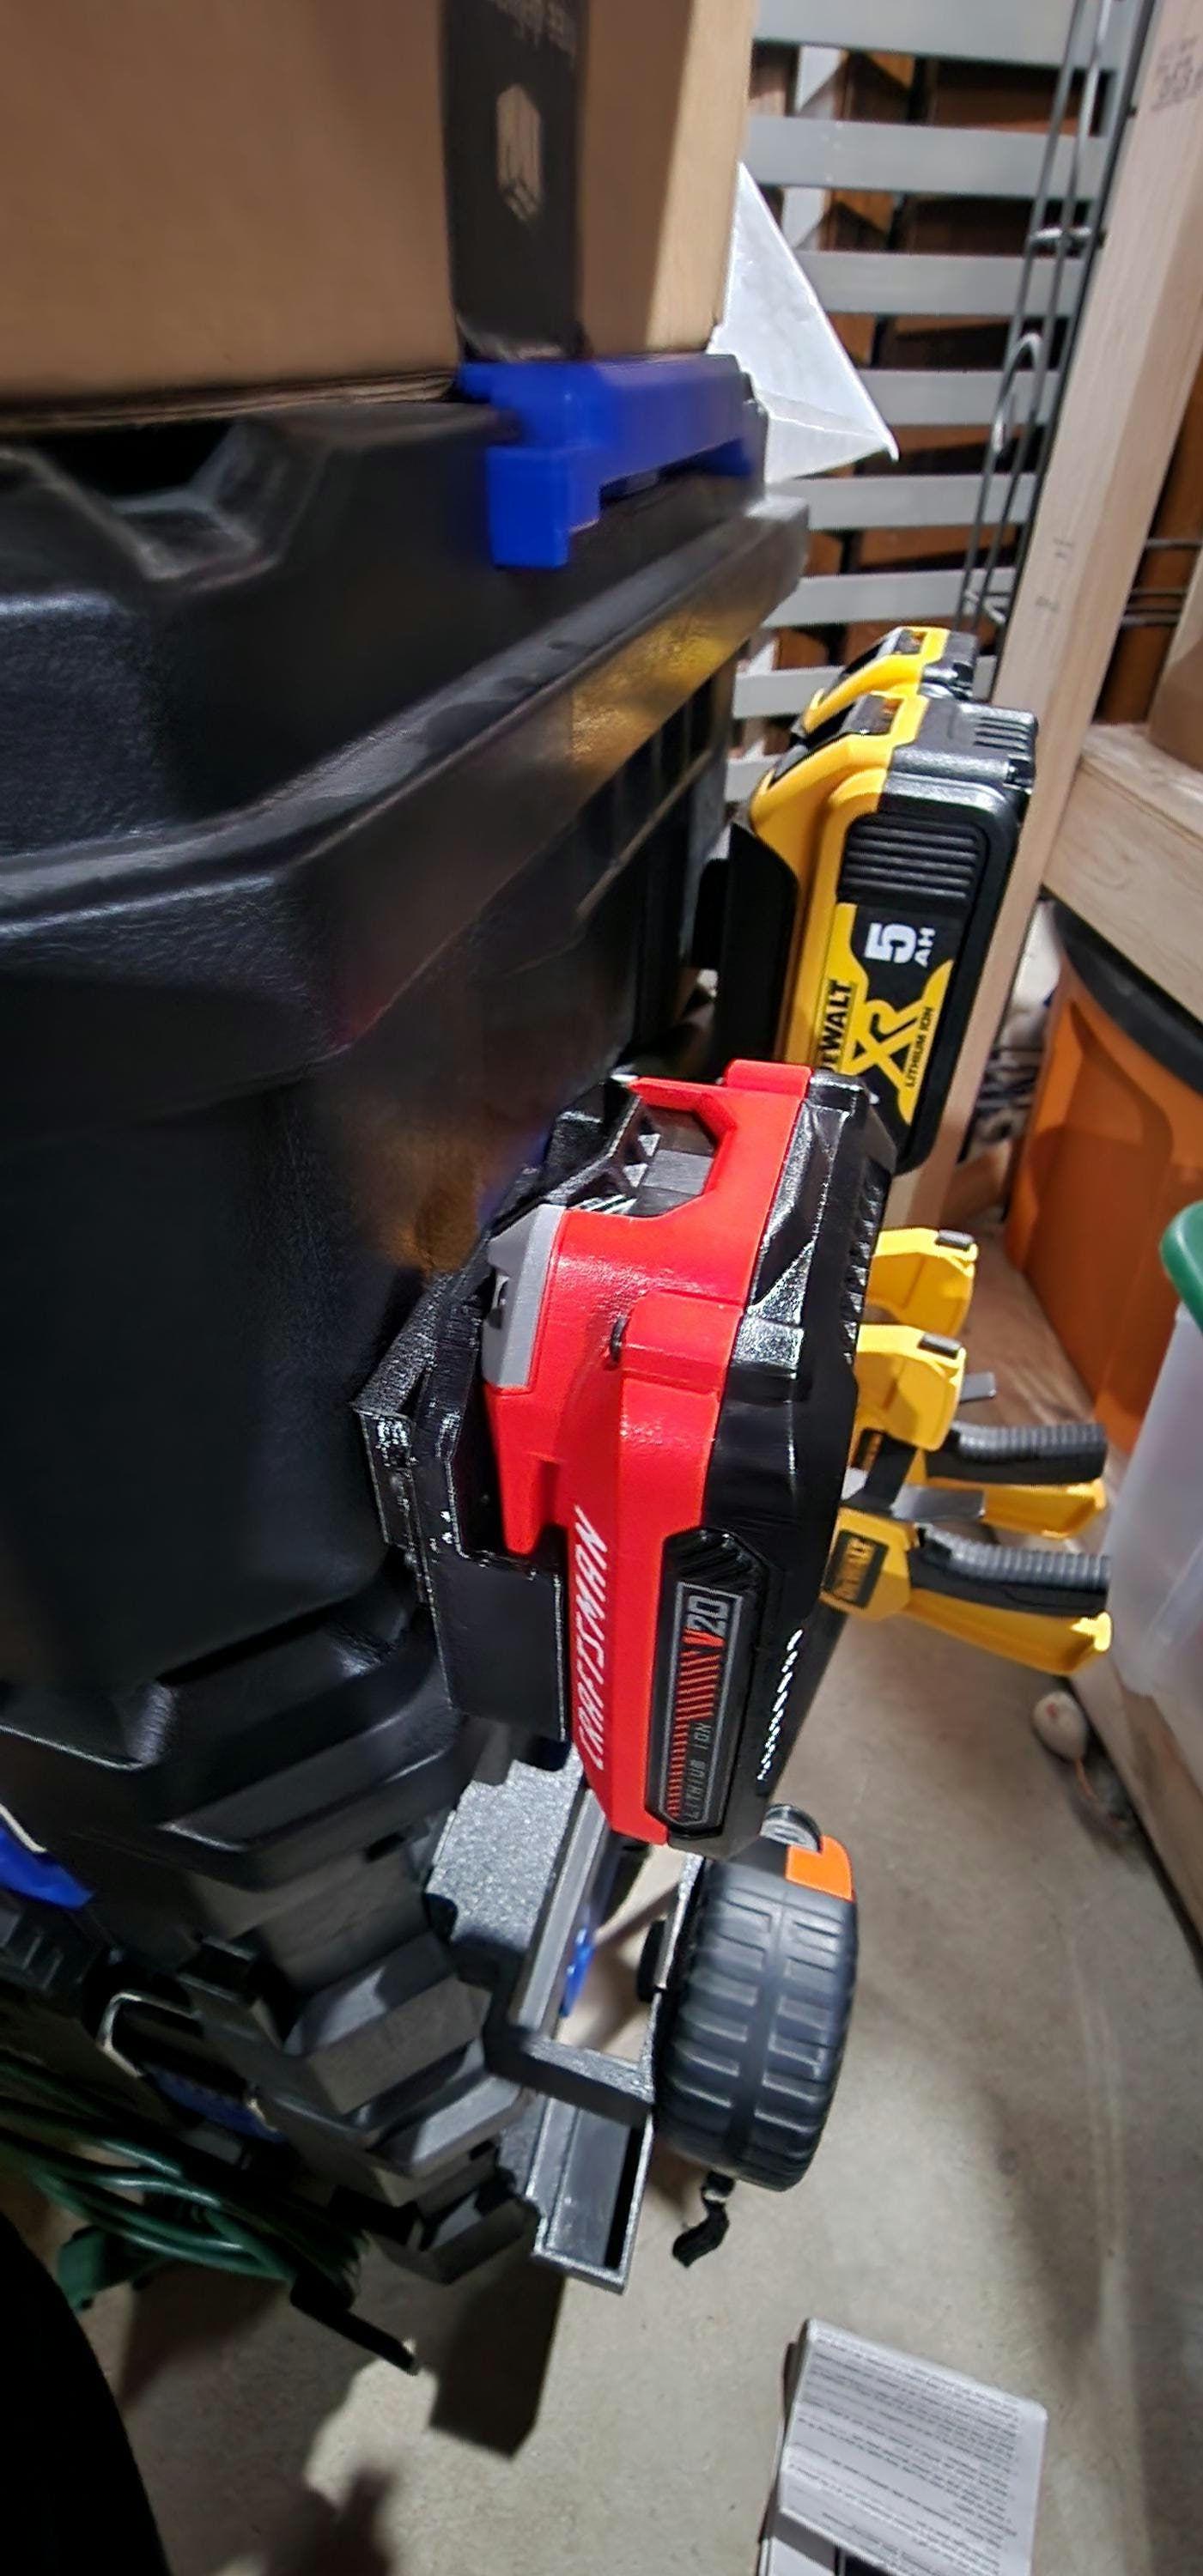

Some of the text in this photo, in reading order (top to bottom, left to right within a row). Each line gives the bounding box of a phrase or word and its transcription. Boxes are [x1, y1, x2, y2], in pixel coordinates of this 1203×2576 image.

[865, 921, 916, 963] 5
[915, 927, 937, 969] AH
[846, 999, 922, 1089] XR
[904, 1006, 934, 1088] LITHIUM ION
[574, 1504, 608, 1770] CRAFTSMAN
[682, 1595, 729, 1648] V20
[694, 1722, 713, 1750] ION
